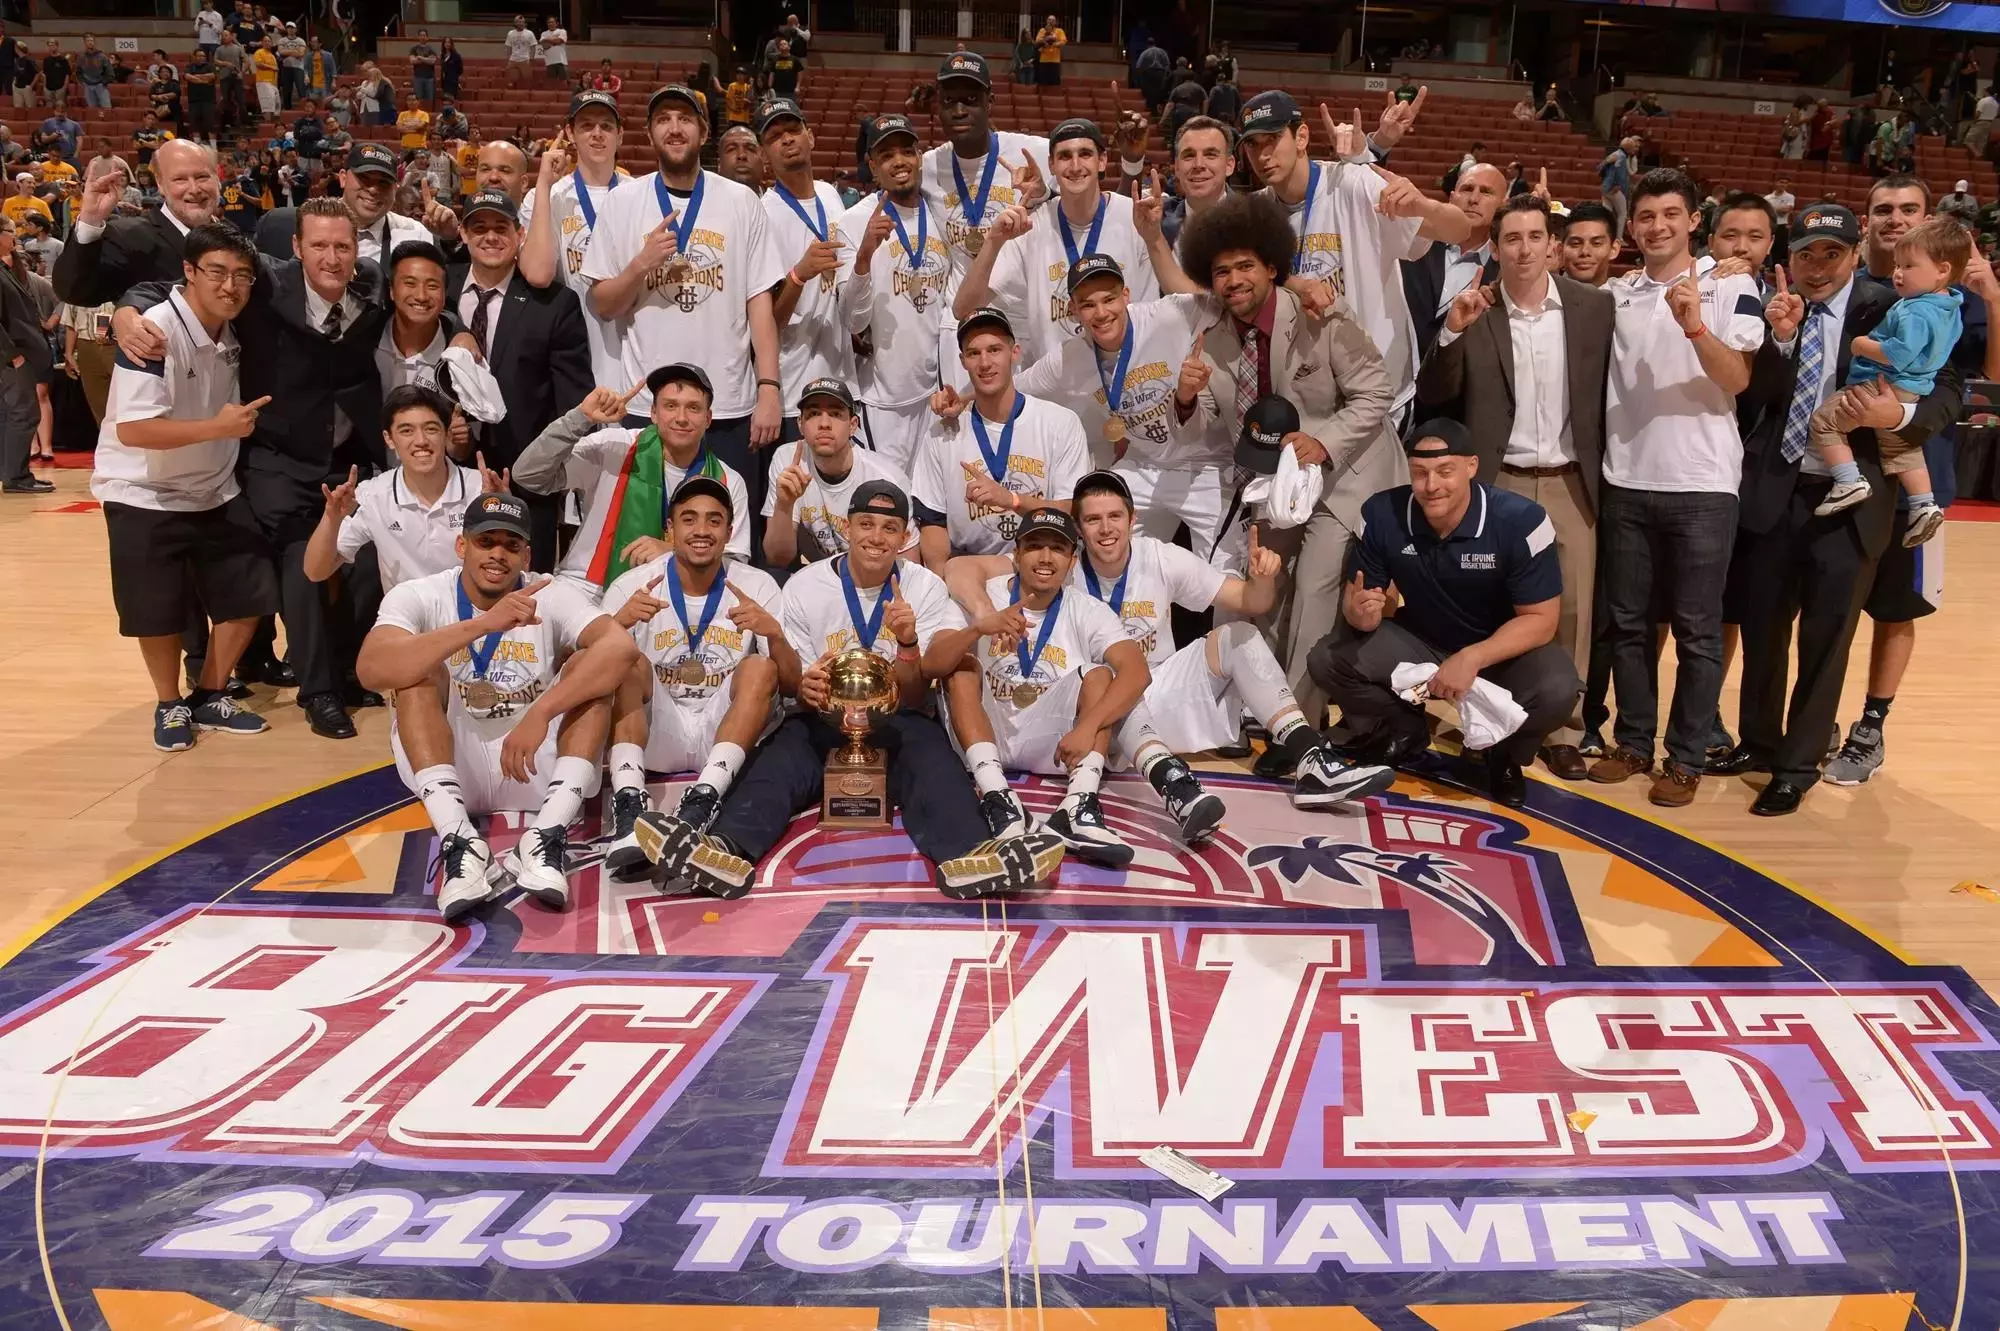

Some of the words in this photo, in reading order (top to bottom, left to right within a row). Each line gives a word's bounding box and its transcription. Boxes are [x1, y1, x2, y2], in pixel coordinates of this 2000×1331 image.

[119, 41, 135, 49] 206
[1368, 80, 1384, 88] 209
[562, 215, 582, 234] UC
[1821, 216, 1843, 226] WEST
[1048, 261, 1068, 281] UC
[1121, 399, 1135, 410] BIG
[1135, 390, 1157, 405] WEST
[1260, 434, 1280, 442] WEST
[1008, 455, 1044, 478] VINE
[487, 503, 500, 511] BIG
[500, 503, 521, 516] WEST
[1461, 553, 1471, 562] UC
[1472, 553, 1496, 562] IRVINE
[1460, 562, 1497, 570] BASKETBALL
[655, 629, 677, 651] UC
[826, 628, 848, 653] UC
[489, 671, 517, 683] WEST
[1005, 665, 1019, 676] BIG
[0, 913, 740, 1156] BIG
[800, 924, 1994, 1160] WEST
[158, 1188, 640, 1264] 2015
[690, 1196, 1834, 1270] TOURNAMENT
